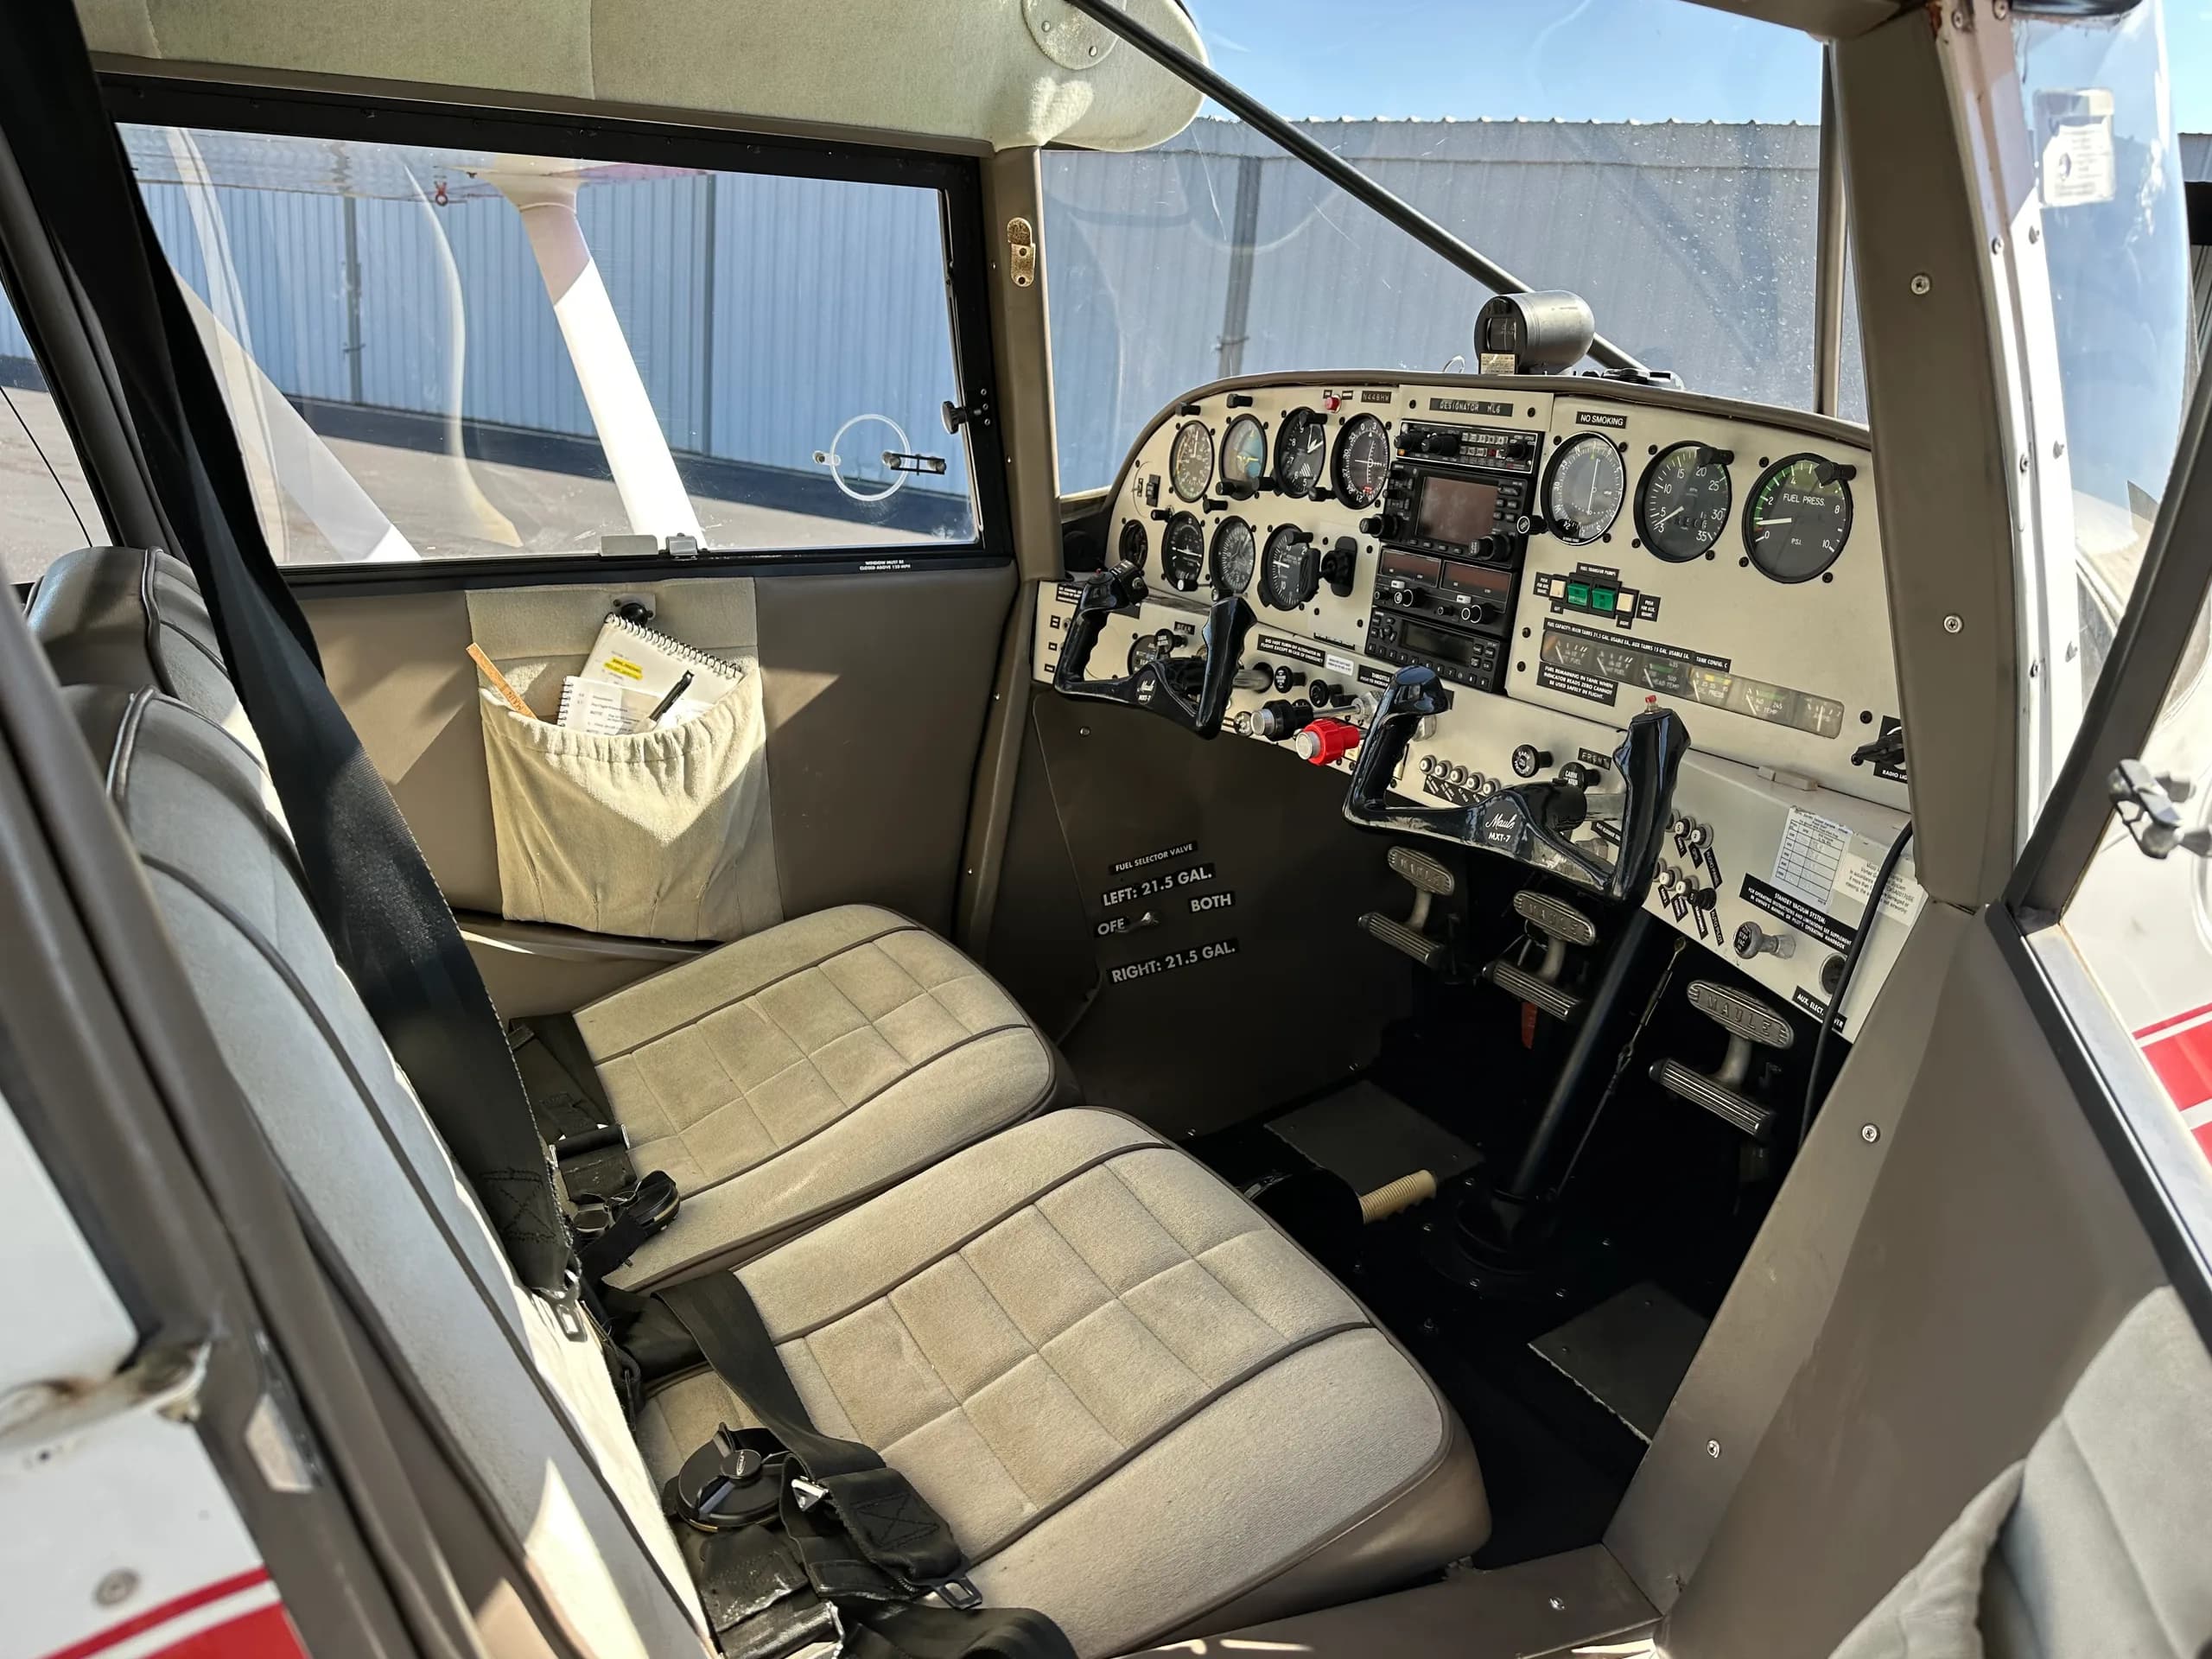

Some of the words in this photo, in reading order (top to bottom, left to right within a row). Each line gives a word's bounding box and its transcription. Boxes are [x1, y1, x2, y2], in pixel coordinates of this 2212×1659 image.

[1440, 401, 1479, 412] DESIGNATOR
[1592, 415, 1624, 426] SMOKING
[1677, 468, 1685, 479] 15
[1695, 467, 1707, 477] 20
[1663, 484, 1672, 494] 10
[1708, 480, 1719, 491] 25
[1768, 496, 1774, 505] 2
[1783, 493, 1800, 503] FUEL
[1802, 495, 1826, 506] PRESS.
[1660, 506, 1666, 517] 5
[1711, 509, 1724, 520] 30
[1834, 505, 1840, 514] 8
[1658, 524, 1664, 533] 3
[1696, 530, 1707, 542] 35
[1764, 531, 1770, 539] 0
[1822, 539, 1830, 549] 10
[1543, 671, 1567, 683] INDICATOR
[1567, 677, 1580, 686] READS
[1580, 681, 1593, 690] ZERO
[1592, 685, 1612, 696] CANNOT
[1554, 669, 1580, 679] REMAINING
[1599, 680, 1613, 689] WHEN
[1567, 684, 1582, 693] SAFELY
[1587, 690, 1605, 699] FLIGHT.
[1882, 769, 1899, 779] RADIO
[1488, 832, 1511, 842] MXT-7
[1116, 861, 1134, 872] FUEL
[1134, 851, 1168, 867] SELECTOR
[1170, 843, 1193, 857] VALVE
[1103, 887, 1137, 906] LEFT:
[1141, 875, 1173, 896] 21.5
[1178, 867, 1212, 885] GAL.
[1191, 893, 1232, 912] BOTH
[1774, 892, 1792, 906] STANDBY
[1792, 900, 1809, 915] VACUUM
[1529, 904, 1580, 936] MAULE
[1754, 890, 1772, 904] OPERATING
[1795, 912, 1803, 920] AND
[1830, 930, 1853, 946] SUPPLEMENT
[1097, 918, 1124, 936] OFF
[1824, 933, 1846, 950] HANDBOOK
[1111, 960, 1162, 983] RIGHT:
[1165, 950, 1198, 969] 21.5
[1202, 942, 1236, 959] GAL.
[1796, 993, 1809, 1007] AUX.
[1809, 1002, 1825, 1016] ELECT.
[1707, 995, 1772, 1037] MAULE
